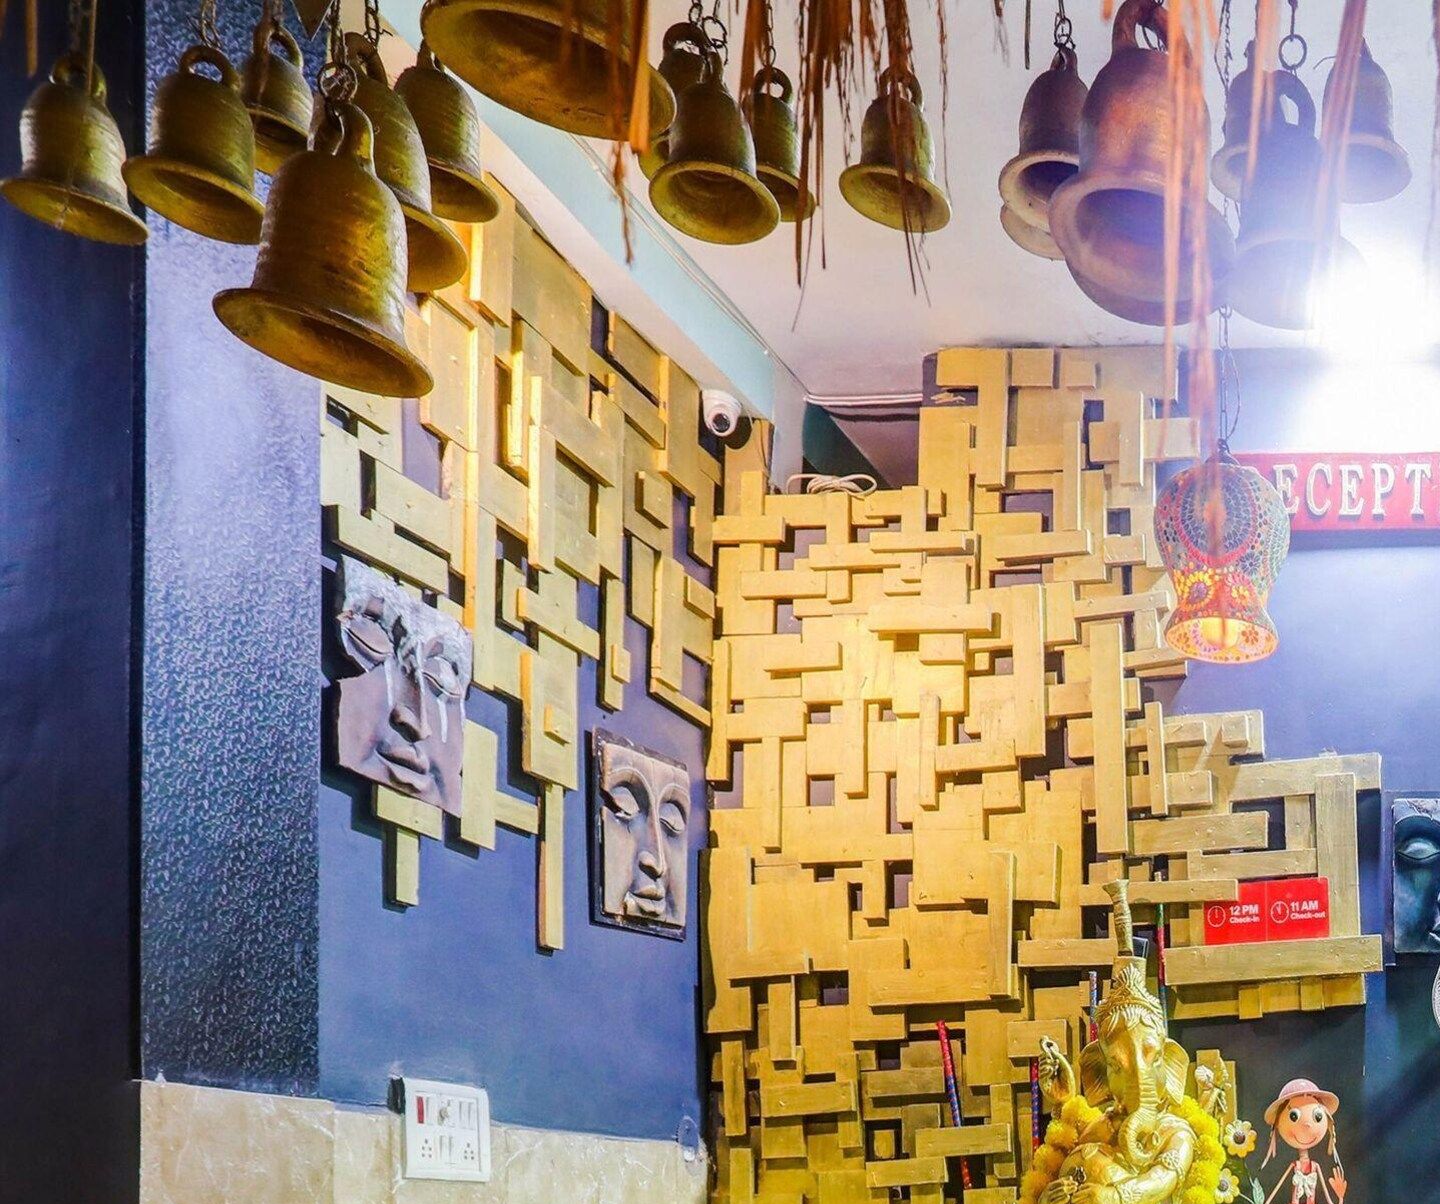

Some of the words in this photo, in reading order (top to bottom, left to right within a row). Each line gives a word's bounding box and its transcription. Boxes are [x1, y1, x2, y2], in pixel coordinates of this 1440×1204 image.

[1230, 905, 1241, 915] 12
[1242, 904, 1259, 914] PM
[1290, 901, 1299, 911] 11
[1301, 900, 1319, 911] AM
[1229, 915, 1260, 924] Check-in
[1290, 911, 1326, 920] Check-out
